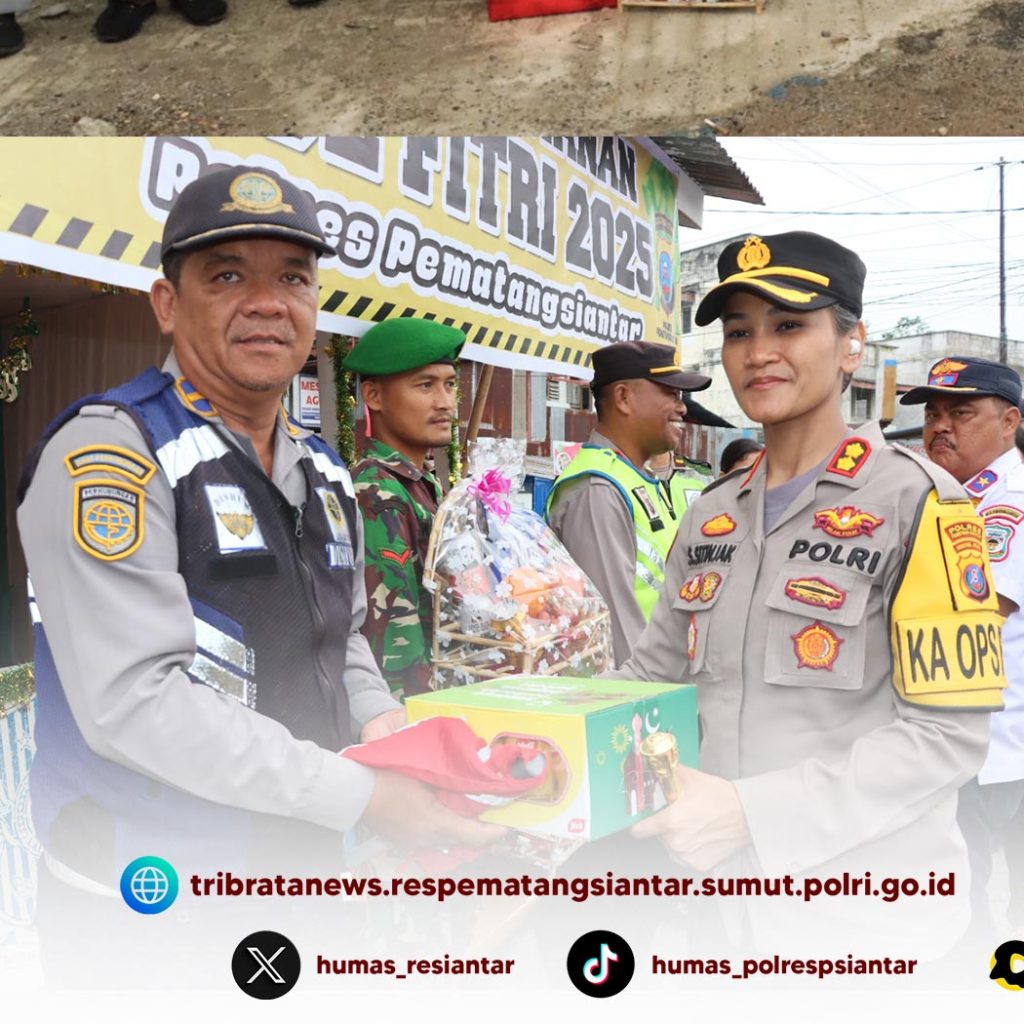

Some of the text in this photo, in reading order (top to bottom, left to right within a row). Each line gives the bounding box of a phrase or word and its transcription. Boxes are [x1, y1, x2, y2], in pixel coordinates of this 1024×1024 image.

[402, 136, 556, 257] FITRI
[565, 182, 653, 298] 2025
[381, 217, 644, 344] Pematangsiantar
[789, 539, 881, 574] POLRI
[907, 624, 1000, 683] KA OPS
